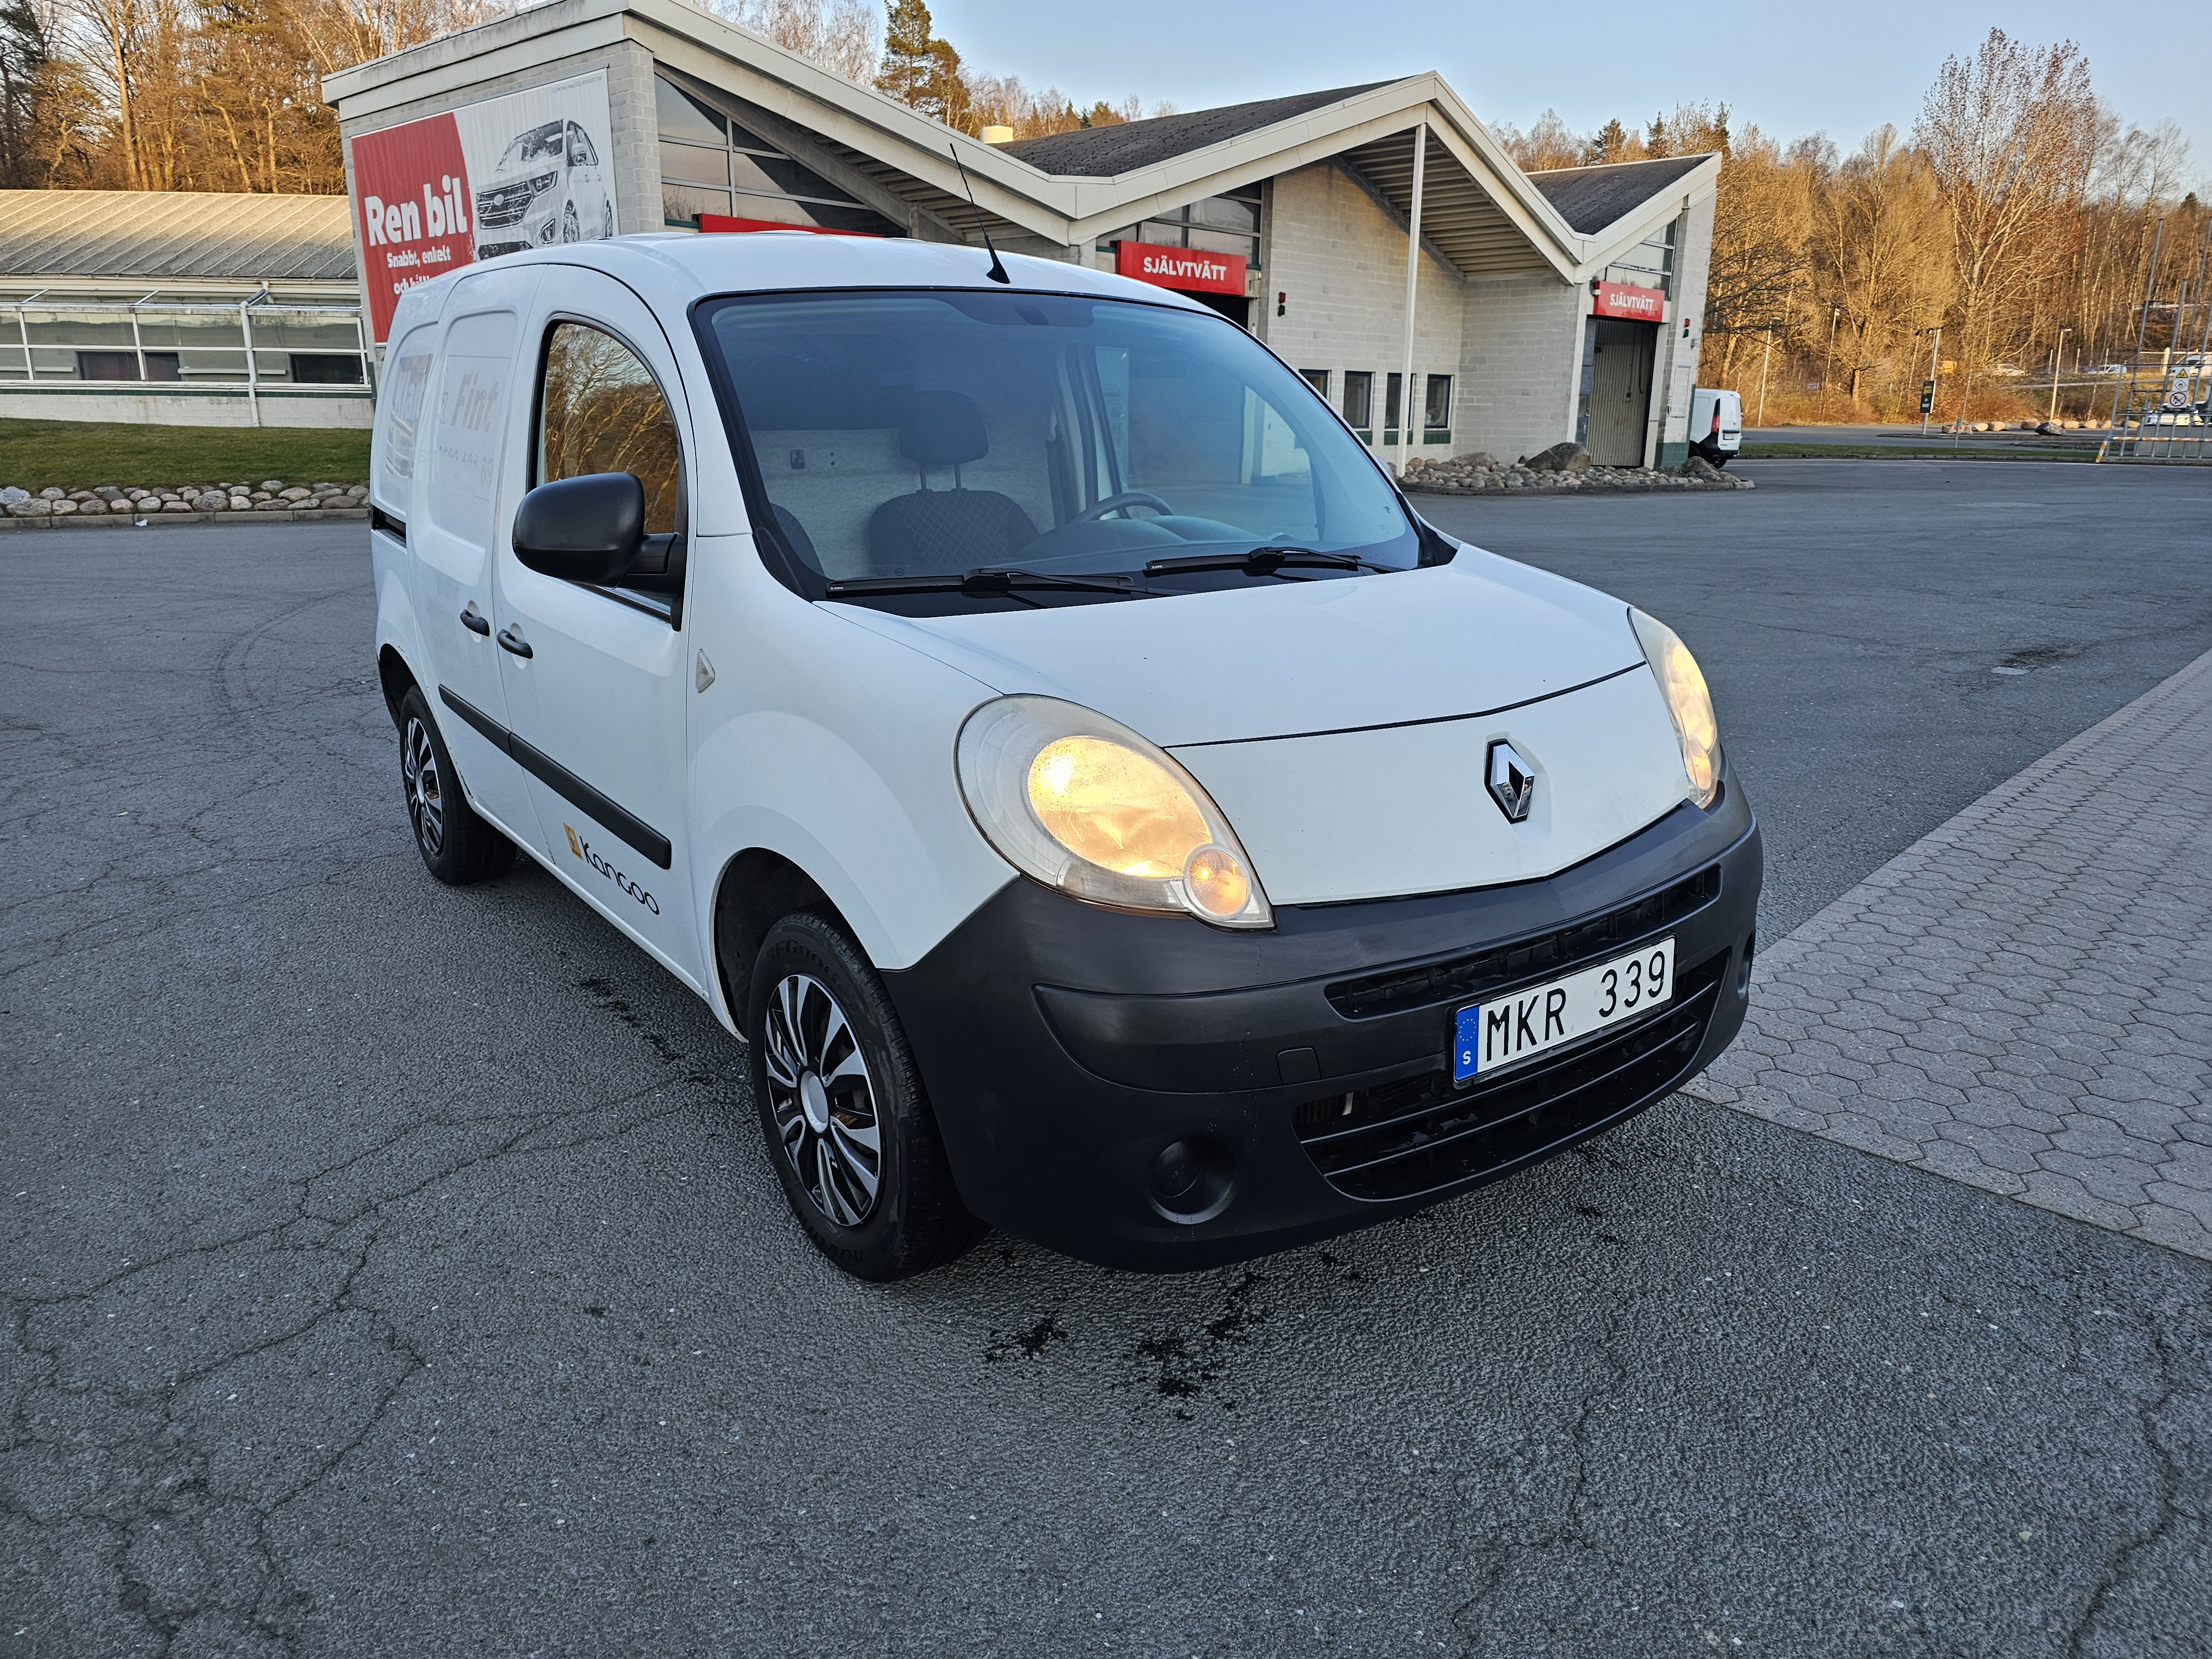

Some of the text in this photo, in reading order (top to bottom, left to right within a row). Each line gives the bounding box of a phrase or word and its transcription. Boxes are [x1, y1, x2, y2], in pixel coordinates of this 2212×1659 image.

[364, 175, 468, 247] Ren bil
[387, 244, 451, 268] Snabbt, enkelt
[1143, 255, 1227, 281] SJÄLVTVÄTT
[1609, 293, 1654, 311] SJÄLVTVÄTT
[1486, 950, 1666, 1062] MKR 339
[1462, 1050, 1471, 1065] S
